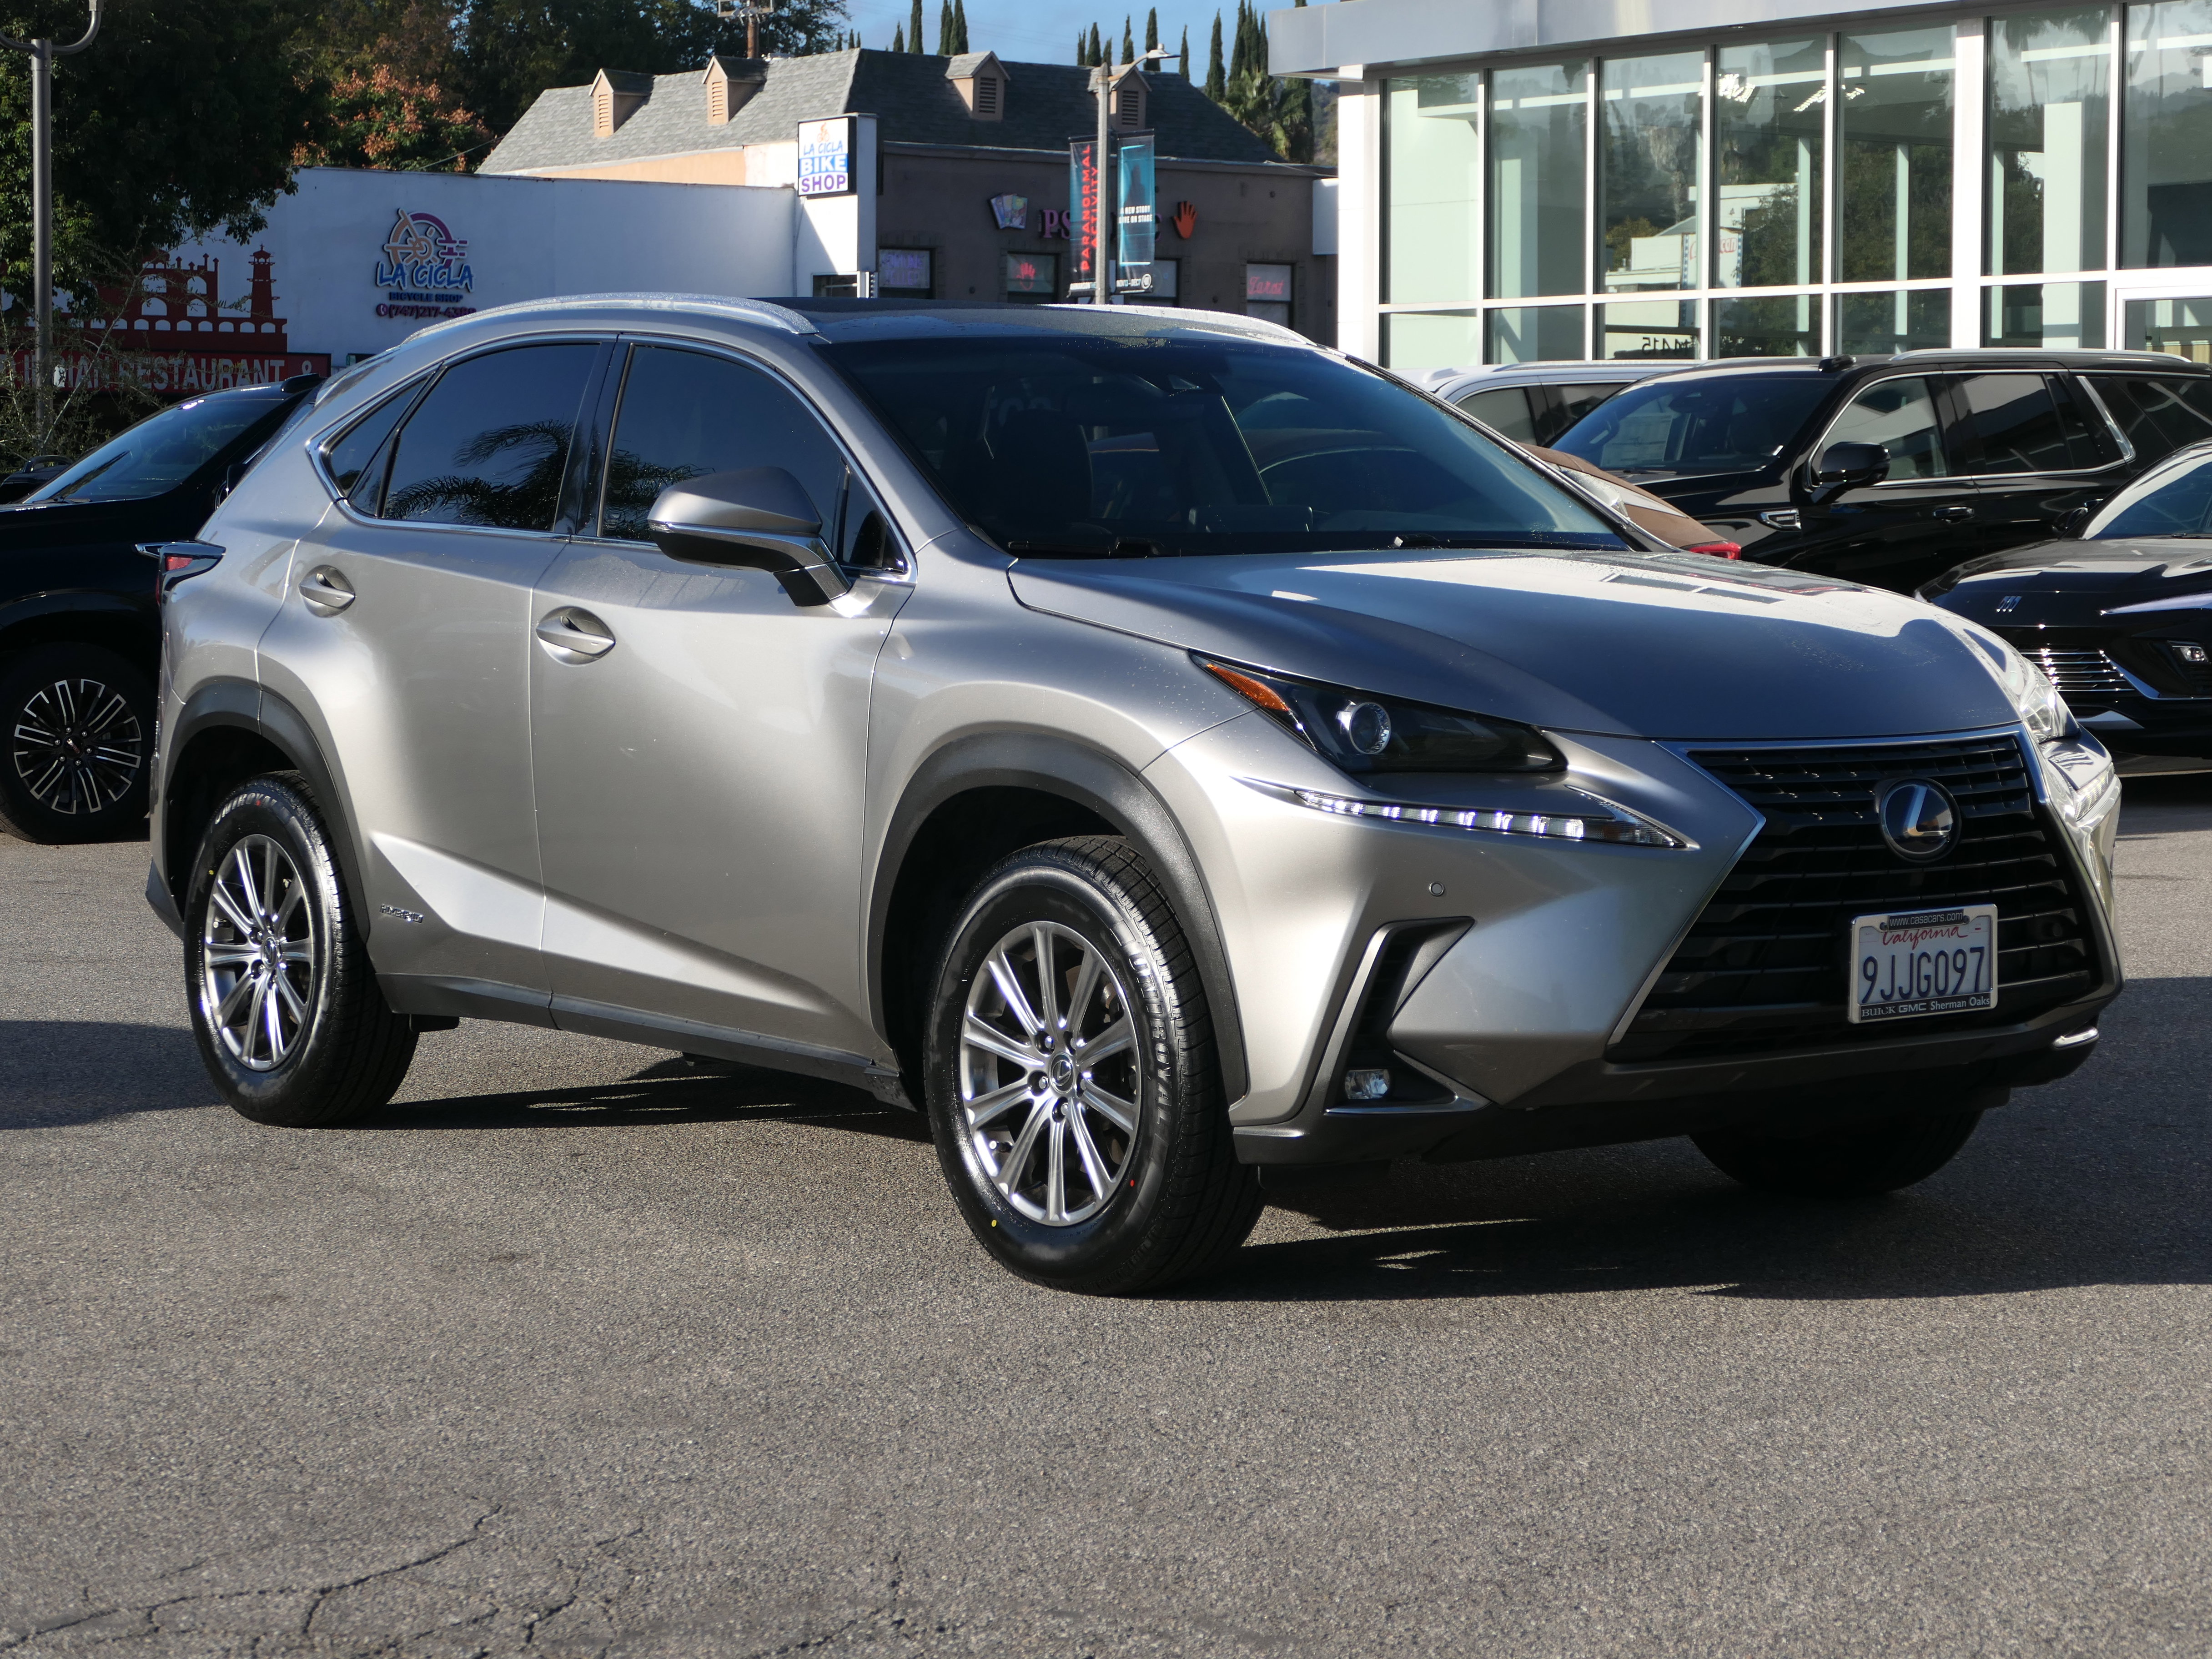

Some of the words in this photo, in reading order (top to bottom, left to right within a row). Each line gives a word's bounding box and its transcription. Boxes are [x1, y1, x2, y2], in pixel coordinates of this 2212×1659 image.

[804, 144, 814, 155] LA
[818, 140, 843, 154] CICLA
[801, 156, 846, 176] BIKE
[802, 175, 846, 192] SHOP
[1080, 145, 1091, 271] PARANORMAL
[377, 261, 407, 289] LA
[413, 263, 474, 292] CICLA
[389, 292, 433, 302] BICYCLE
[435, 294, 463, 302] SHOP
[119, 356, 285, 390] RESTAURANT
[380, 904, 423, 923] HYBRID
[1890, 912, 1963, 927] www.casacars.com
[1882, 926, 1968, 950] California
[1862, 946, 1985, 1004] 9JJG097
[1861, 1006, 1896, 1017] BUICK
[1898, 1003, 1926, 1013] GMC
[1930, 1000, 1966, 1011] Sherman
[1969, 996, 1990, 1006] Oaks
